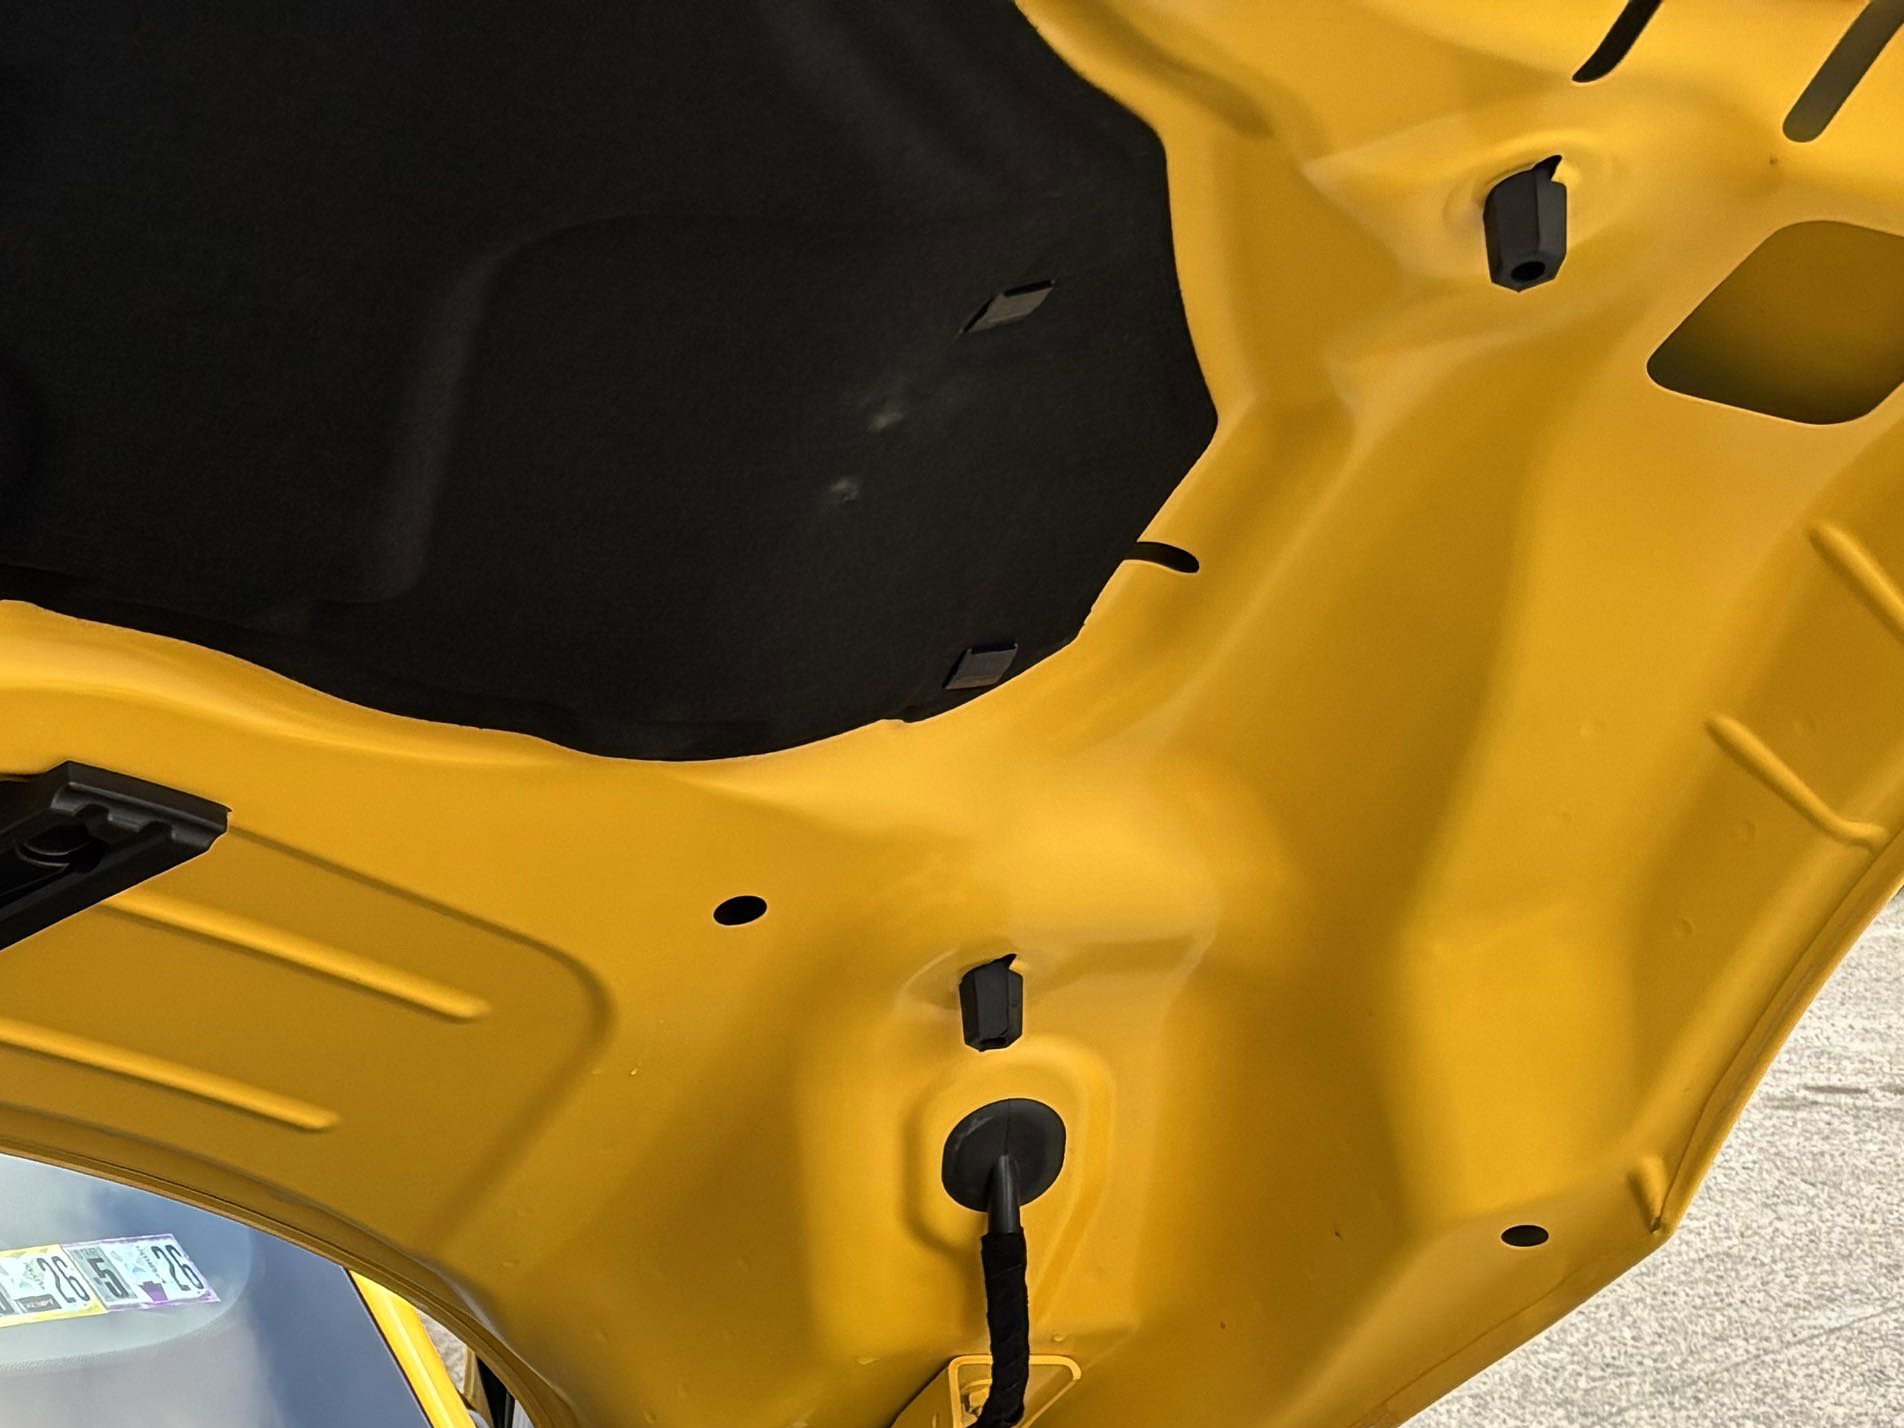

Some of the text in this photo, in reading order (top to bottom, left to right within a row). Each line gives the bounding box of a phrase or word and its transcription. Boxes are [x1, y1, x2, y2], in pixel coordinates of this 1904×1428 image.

[36, 1255, 90, 1303] 26
[87, 1258, 130, 1299] 5
[151, 1244, 205, 1291] 26
